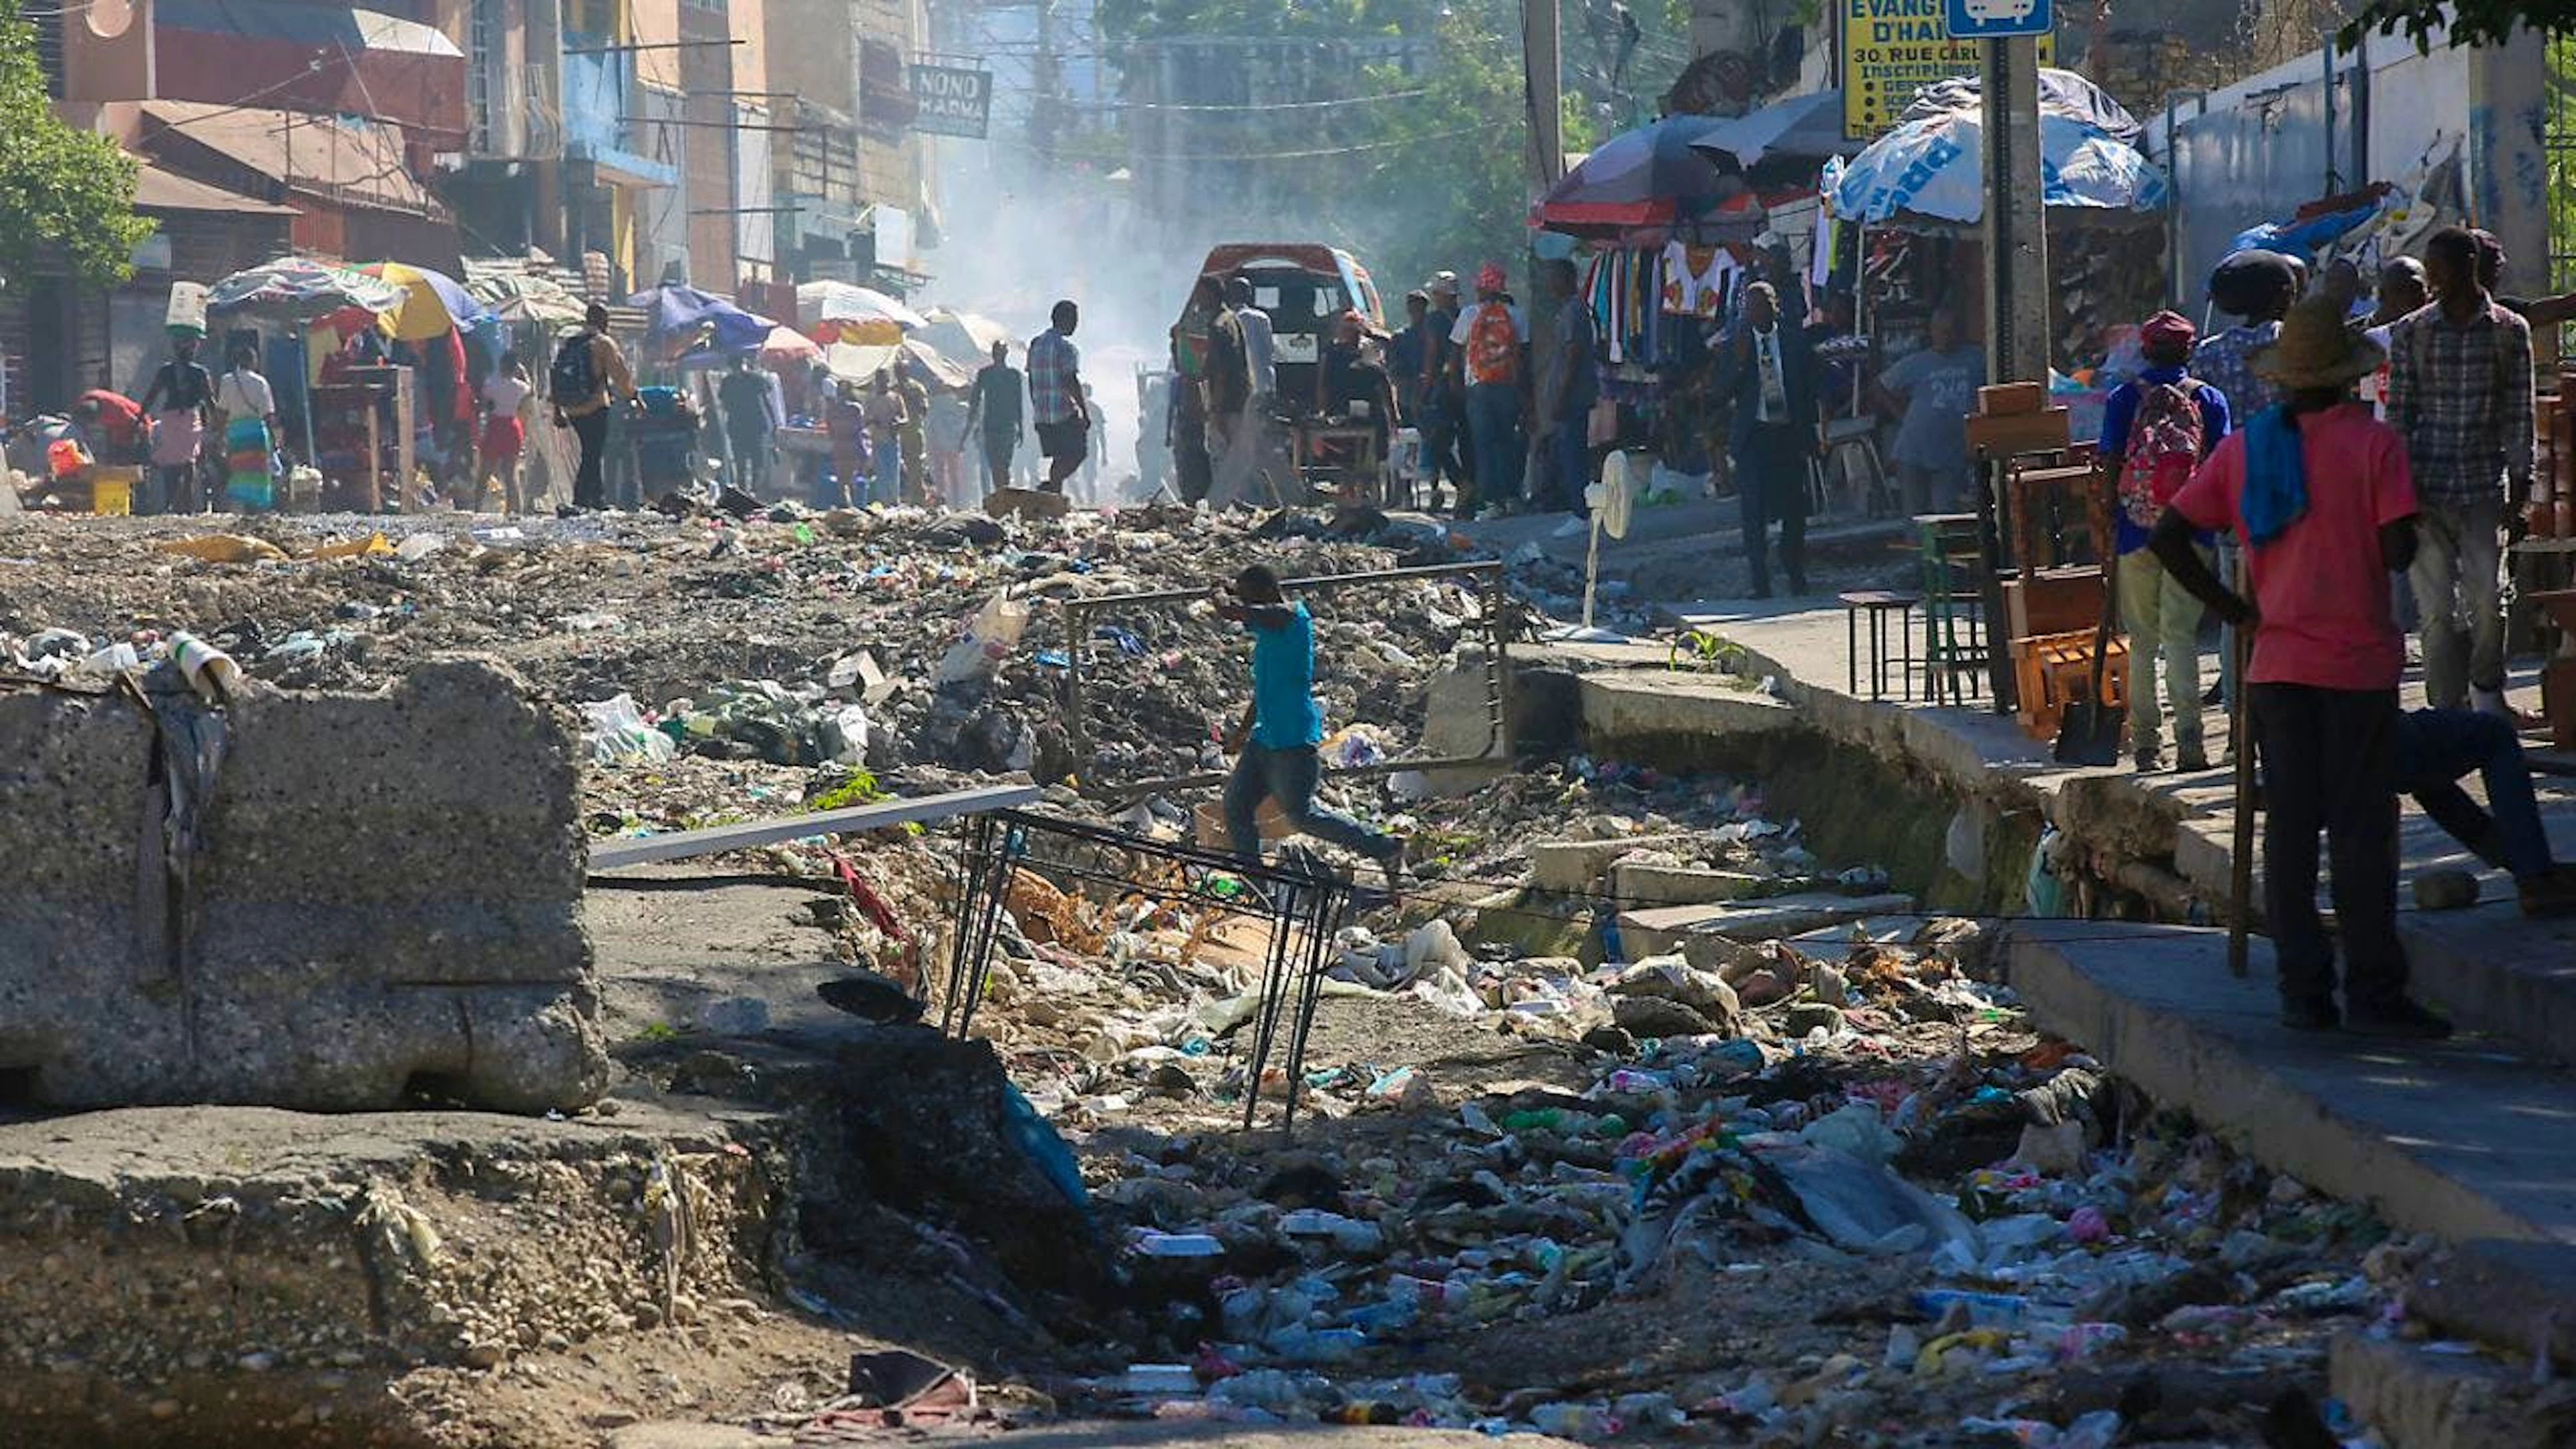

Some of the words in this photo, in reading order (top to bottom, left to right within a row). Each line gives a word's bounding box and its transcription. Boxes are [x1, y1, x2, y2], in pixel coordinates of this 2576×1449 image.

[1873, 18, 1944, 42] D'HAÏ
[1888, 48, 1932, 62] RUE
[1939, 48, 1980, 61] CARL
[918, 71, 979, 99] NONO
